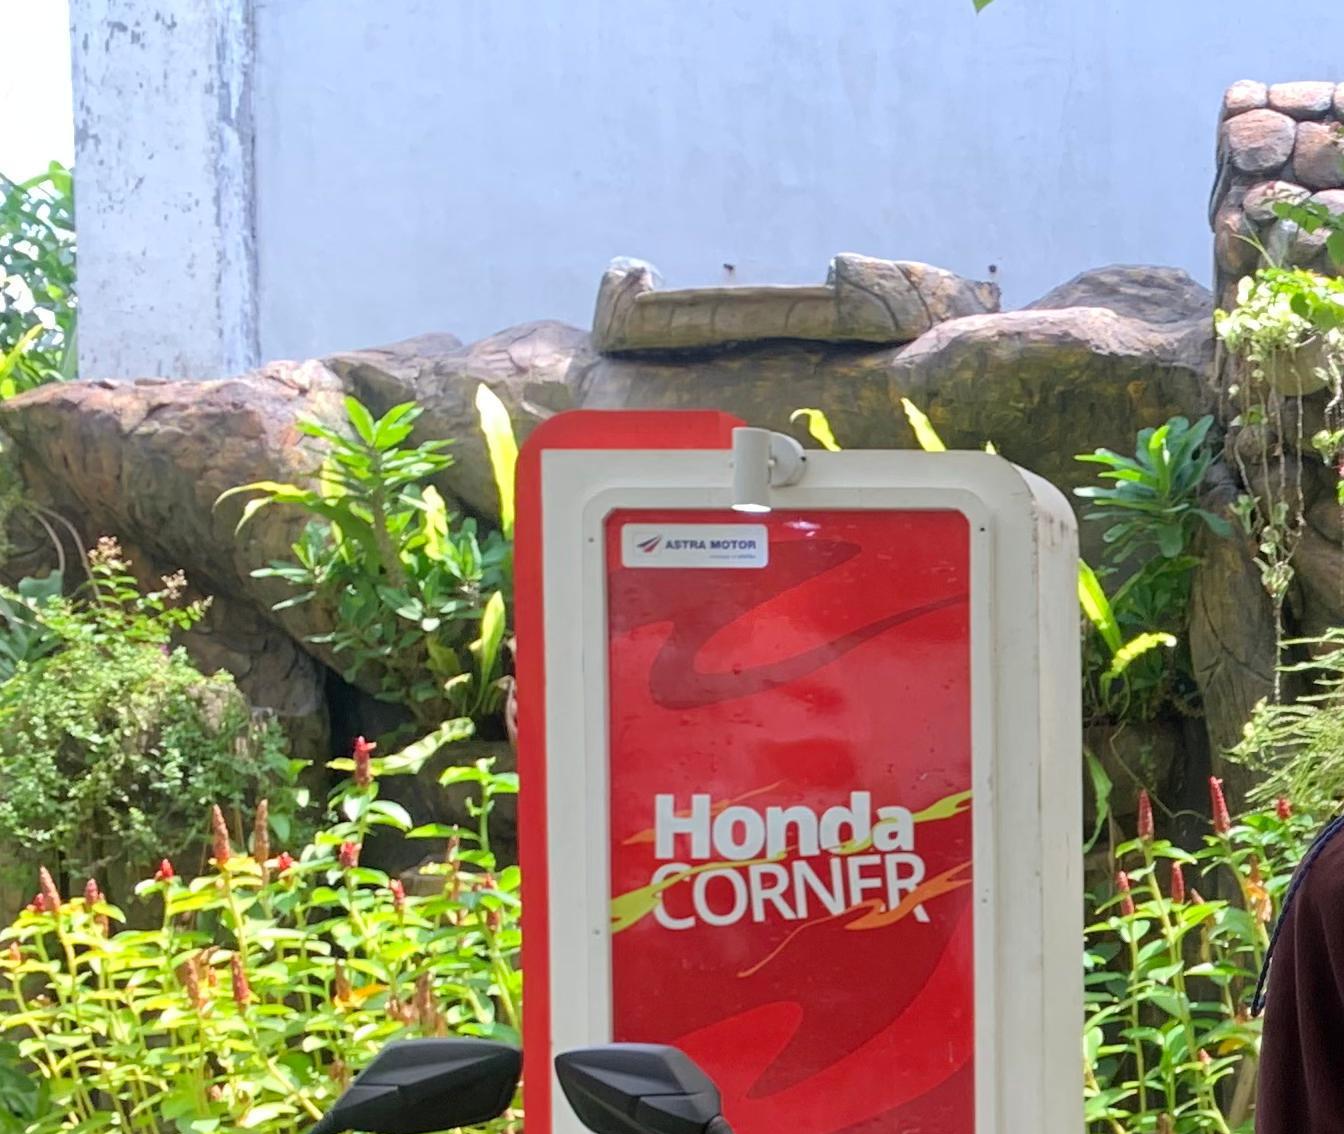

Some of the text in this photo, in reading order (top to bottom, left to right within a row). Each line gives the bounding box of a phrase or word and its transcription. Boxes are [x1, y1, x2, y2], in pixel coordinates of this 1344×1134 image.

[665, 539, 756, 550] ASTRA MOTOR
[654, 791, 914, 861] Honda
[652, 852, 930, 930] CORNER
